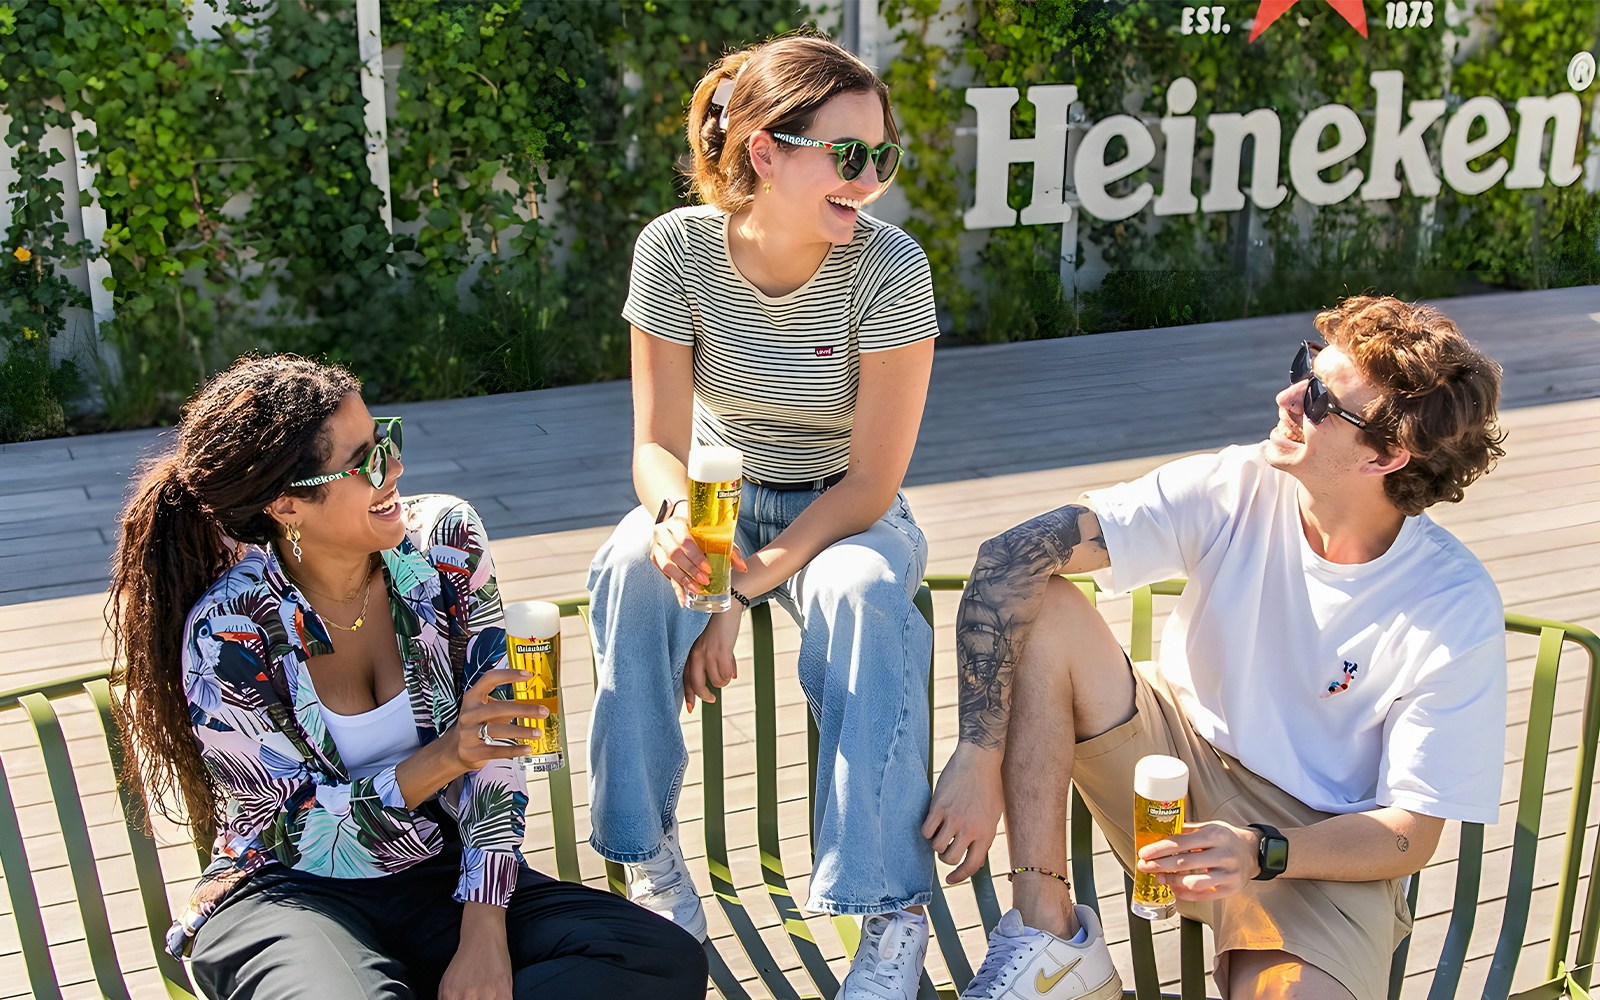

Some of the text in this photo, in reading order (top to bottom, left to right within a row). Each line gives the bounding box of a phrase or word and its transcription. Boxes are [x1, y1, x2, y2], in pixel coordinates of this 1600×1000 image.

[1181, 1, 1434, 35] EST. 1873
[964, 70, 1582, 230] Heineken
[290, 472, 343, 487] eineken
